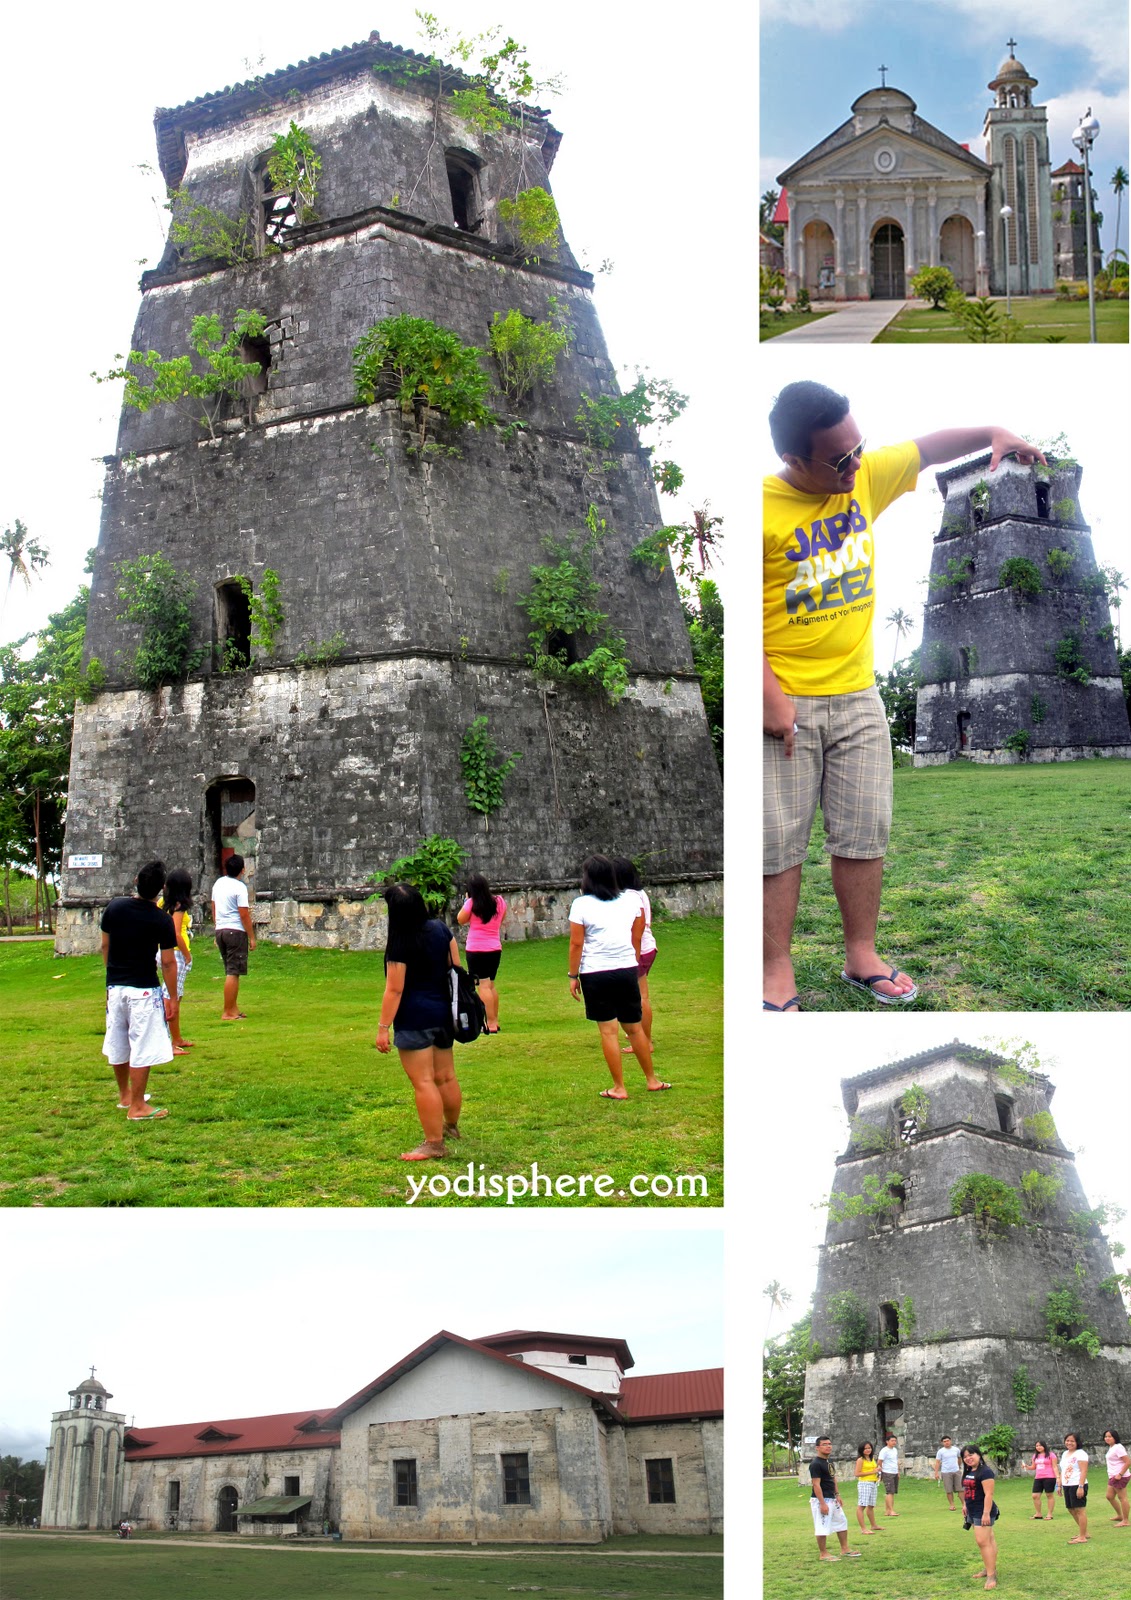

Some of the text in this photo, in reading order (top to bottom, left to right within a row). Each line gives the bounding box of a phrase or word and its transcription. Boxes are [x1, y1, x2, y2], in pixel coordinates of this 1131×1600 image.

[785, 499, 867, 562] JABB
[785, 565, 873, 614] KEEZ
[796, 614, 829, 626] Figment
[830, 611, 837, 621] of
